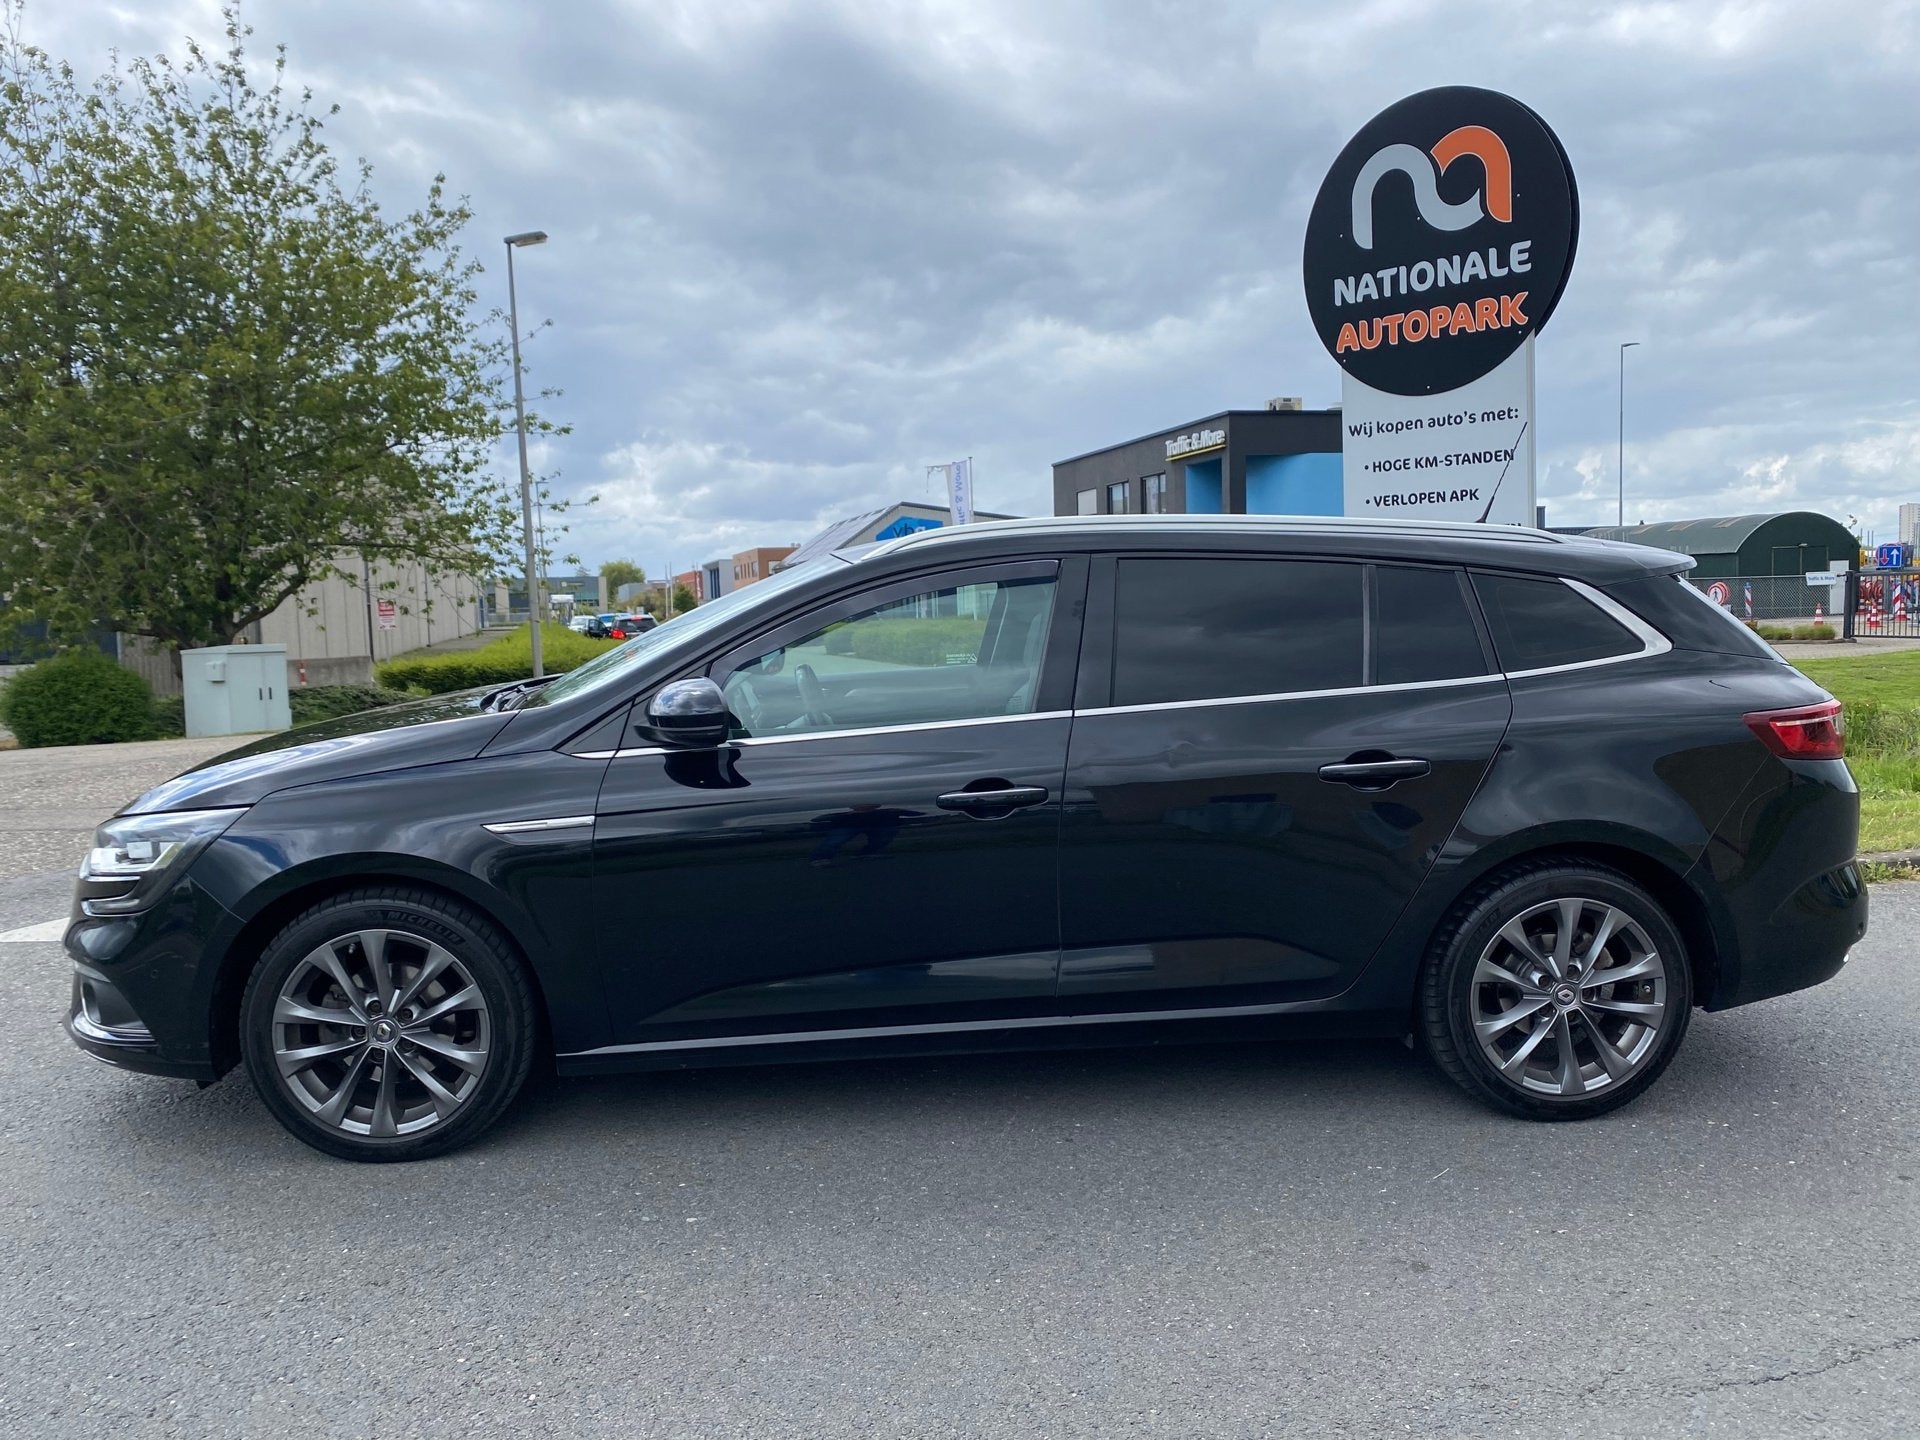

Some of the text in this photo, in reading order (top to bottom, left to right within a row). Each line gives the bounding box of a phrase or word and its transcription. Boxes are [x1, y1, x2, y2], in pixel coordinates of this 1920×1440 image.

[1333, 239, 1533, 307] NATIONALE
[1335, 291, 1530, 354] AUTOPARK
[1348, 406, 1520, 438] Wij kopen auto's met:
[1372, 449, 1515, 473] HOGE KM-STANDEN
[1373, 488, 1480, 508] VERLOPEN APK
